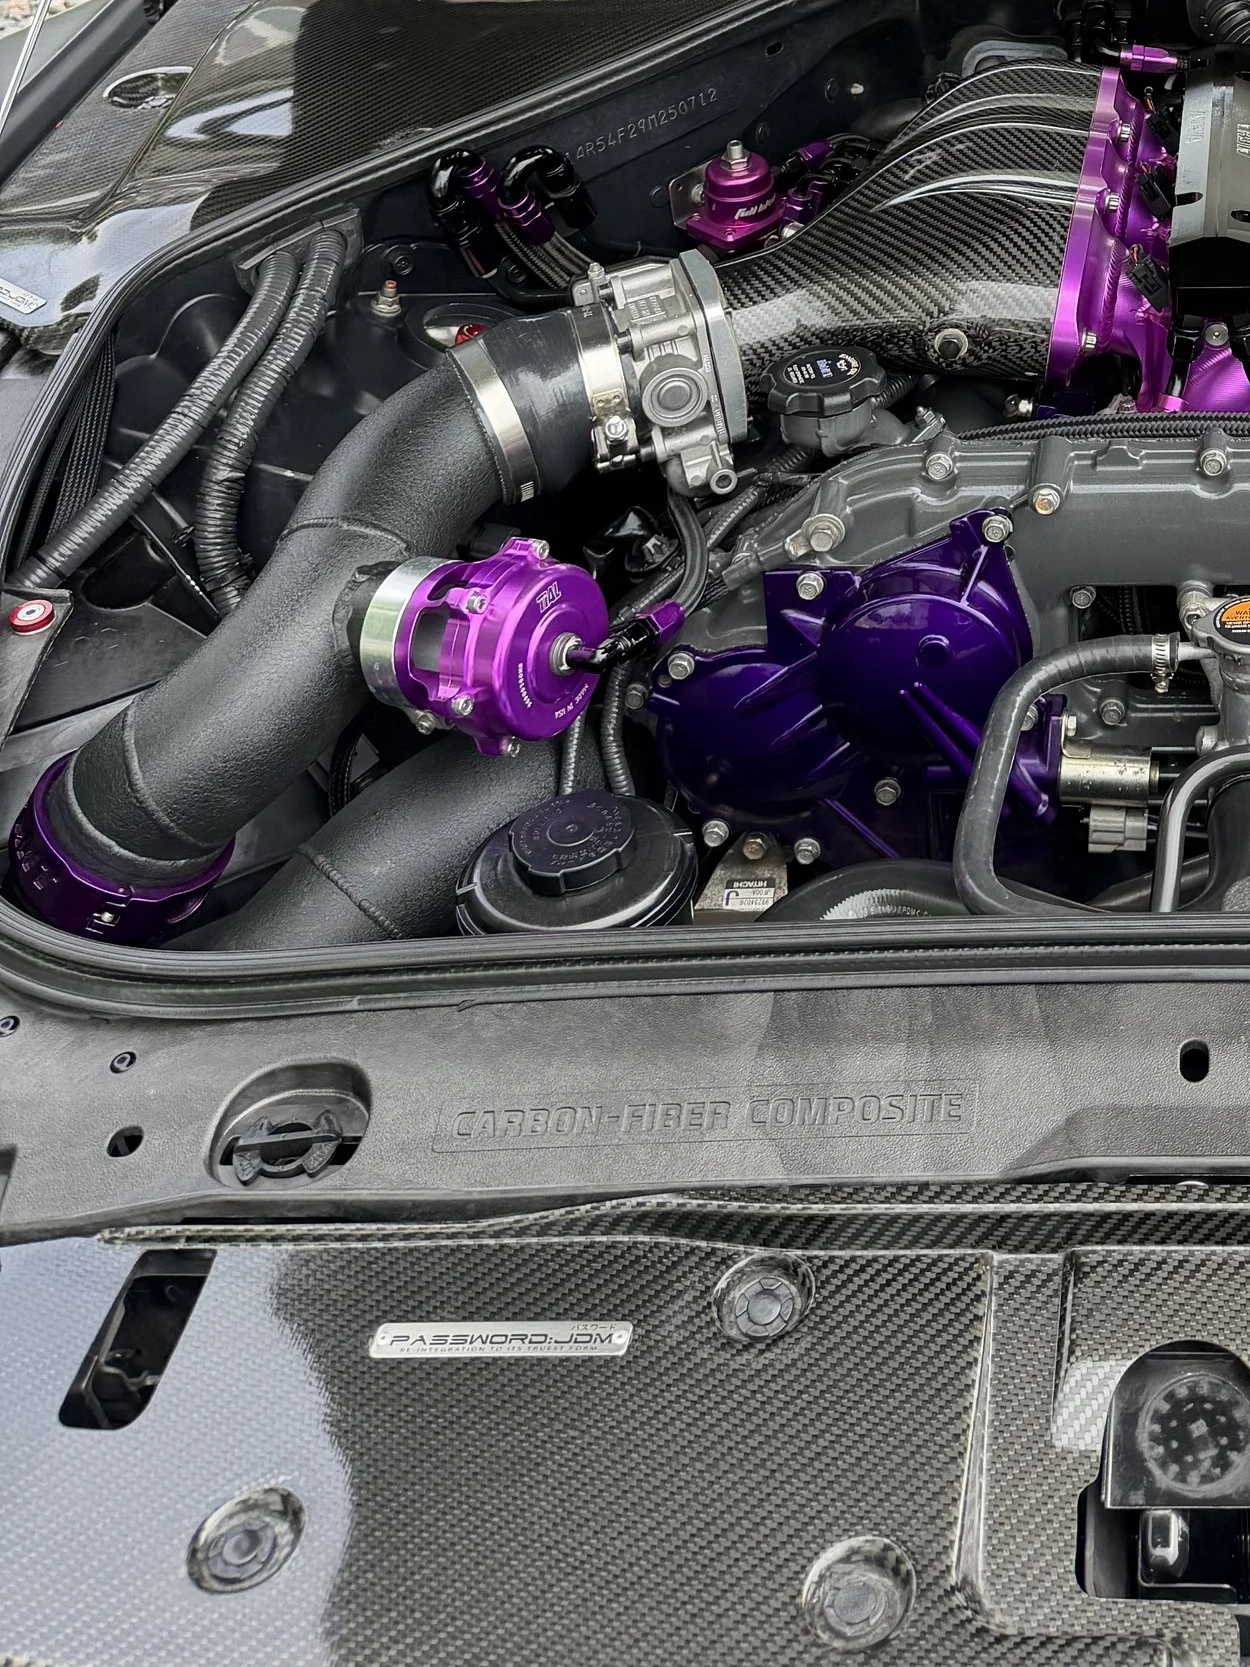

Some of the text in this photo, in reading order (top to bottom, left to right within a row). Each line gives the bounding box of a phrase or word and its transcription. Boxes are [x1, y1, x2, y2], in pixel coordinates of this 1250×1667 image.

[733, 880, 768, 888] HITACHI
[450, 1092, 963, 1140] CARBON-FIBER COMPOSITE
[389, 1333, 614, 1347] PASSWORD:JDM
